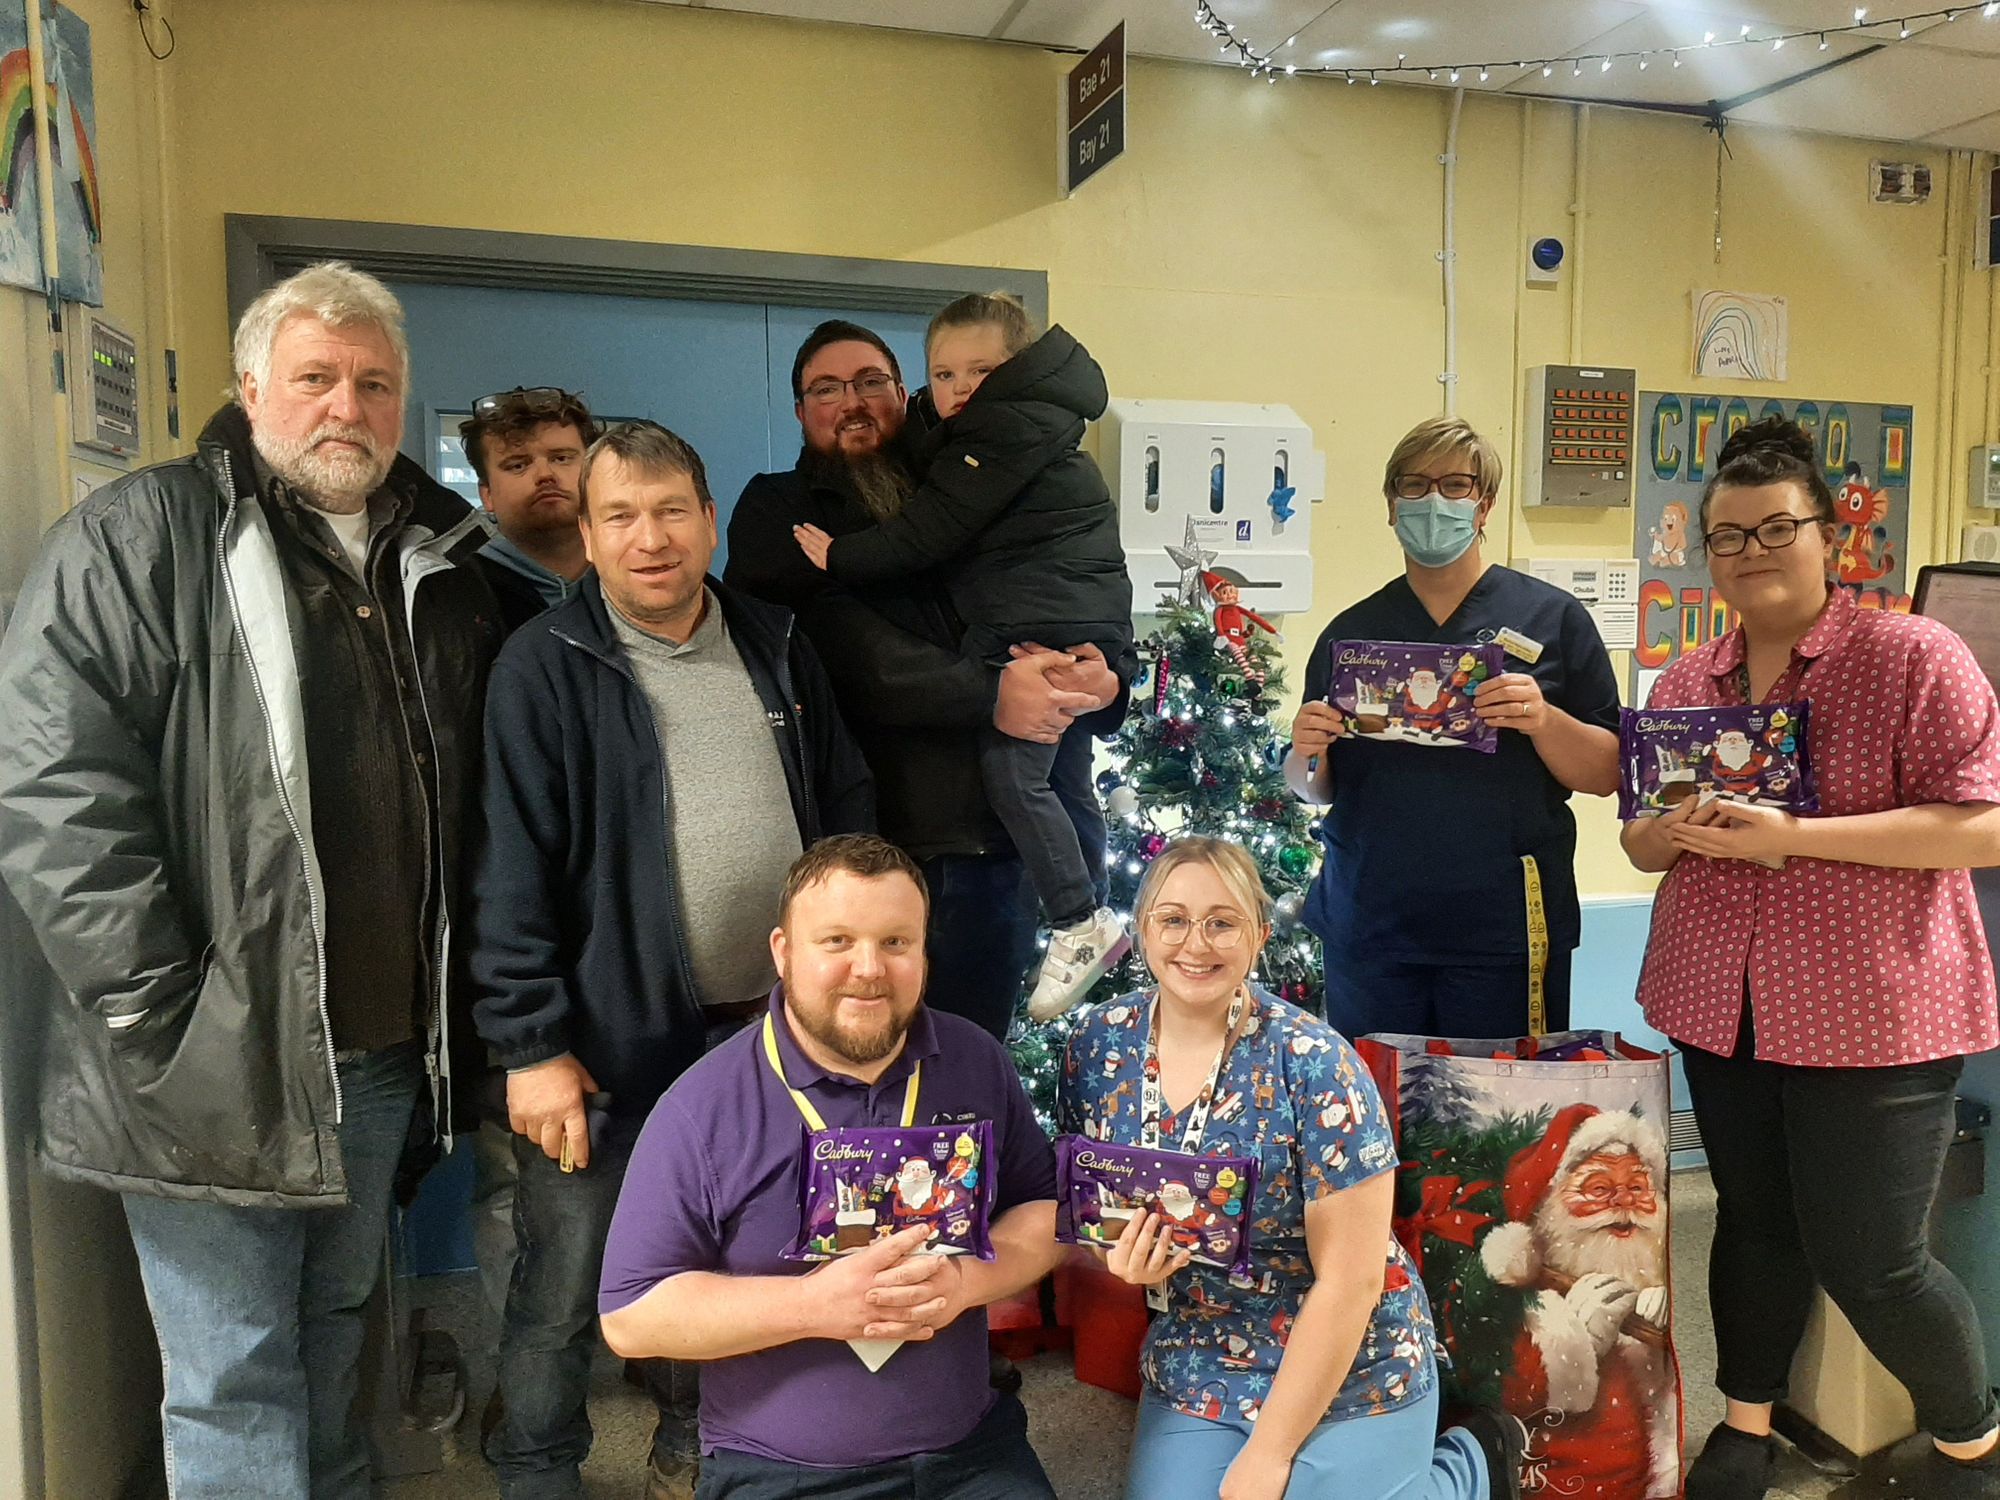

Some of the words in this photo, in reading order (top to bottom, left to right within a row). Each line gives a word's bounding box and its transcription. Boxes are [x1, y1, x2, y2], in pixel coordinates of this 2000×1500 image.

[1079, 73, 1097, 103] Bae
[1100, 53, 1110, 83] 21
[1079, 136, 1097, 165] Bay
[1099, 119, 1110, 150] 21
[1338, 648, 1389, 668] Cadbury
[1635, 716, 1692, 734] Cadbury
[813, 1139, 874, 1163] Cadbury
[1075, 1150, 1135, 1177] Cadbury
[1194, 1171, 1210, 1179] FREE
